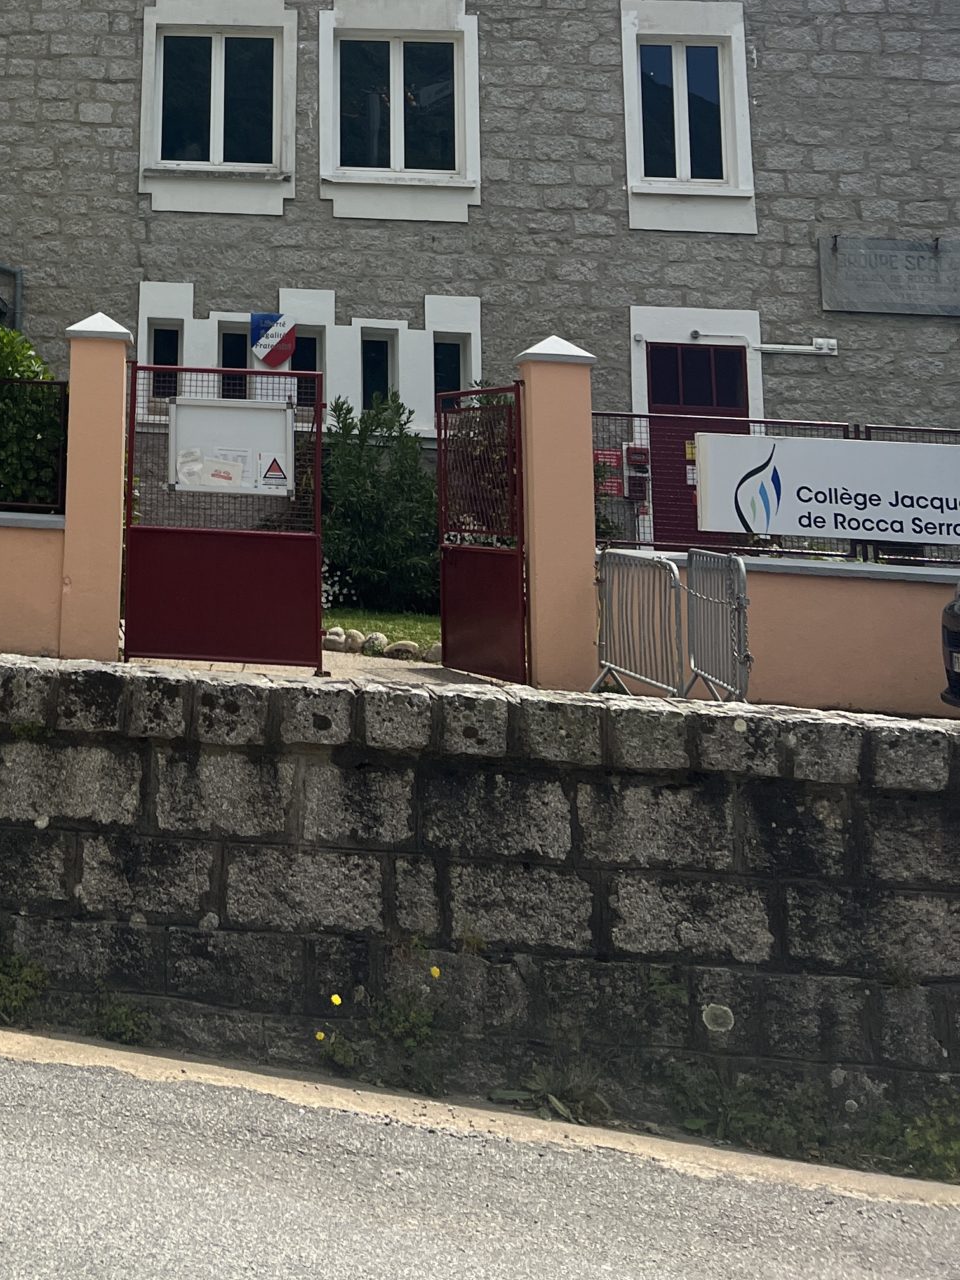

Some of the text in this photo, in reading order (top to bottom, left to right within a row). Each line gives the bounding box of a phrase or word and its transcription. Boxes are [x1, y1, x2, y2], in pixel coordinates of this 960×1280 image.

[259, 328, 287, 339] galité
[796, 486, 960, 514] Collège Jacqu
[798, 511, 826, 529] de
[834, 512, 904, 533] Rocca
